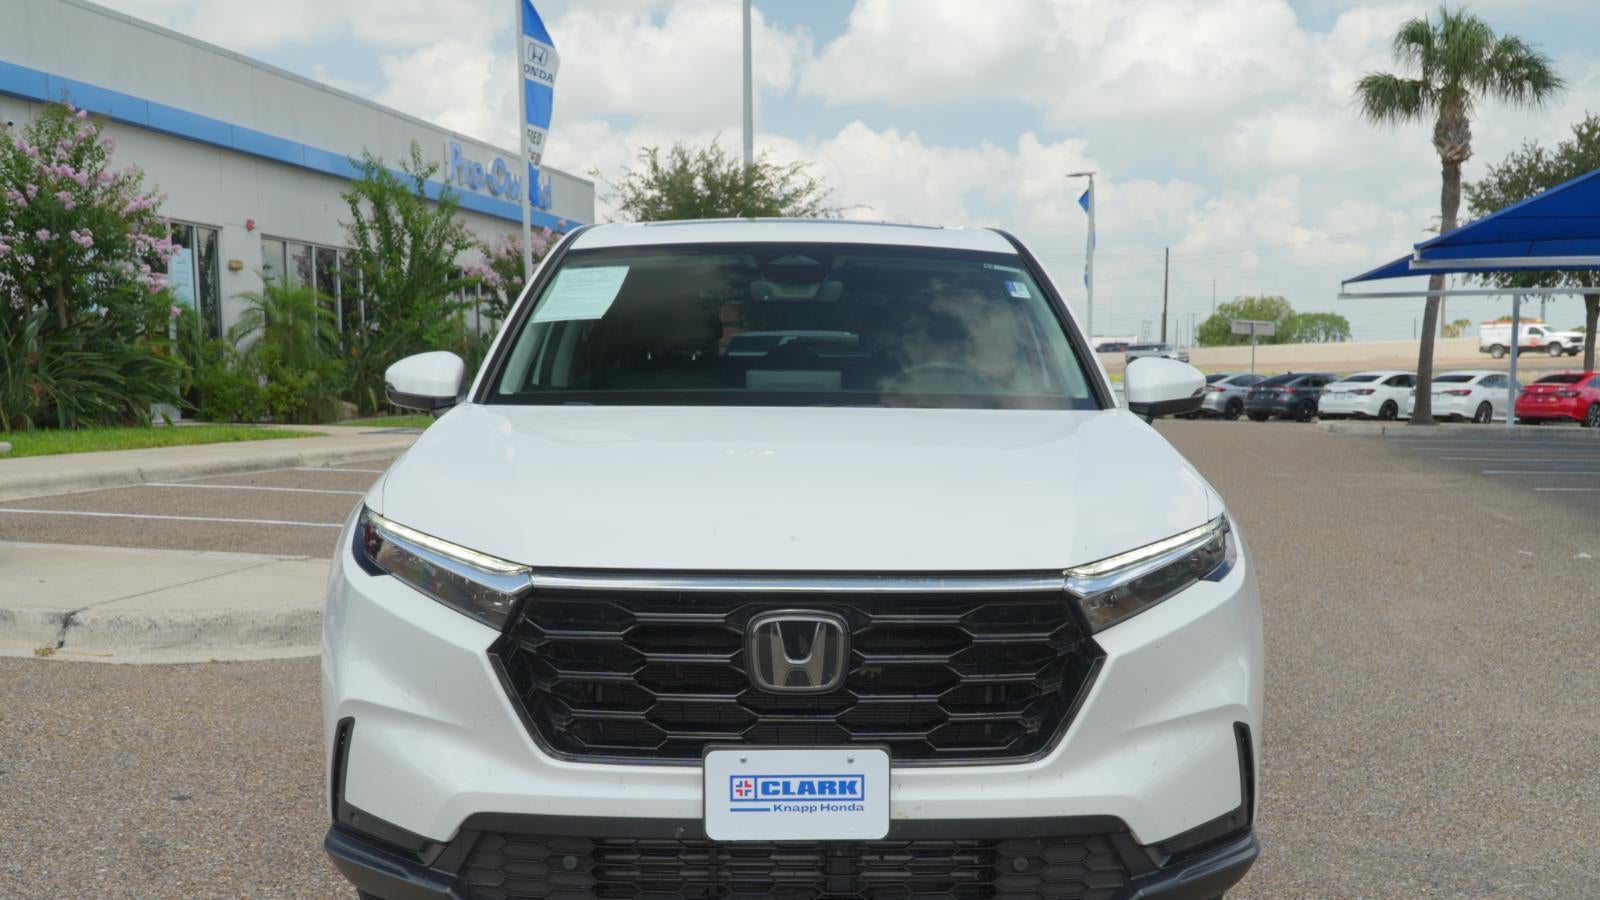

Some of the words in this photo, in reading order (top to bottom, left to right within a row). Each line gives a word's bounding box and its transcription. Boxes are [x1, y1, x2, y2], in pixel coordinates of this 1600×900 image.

[523, 63, 554, 83] ONDA
[761, 780, 858, 796] CLARK
[773, 803, 818, 814] Knapp
[820, 803, 865, 813] Honda
